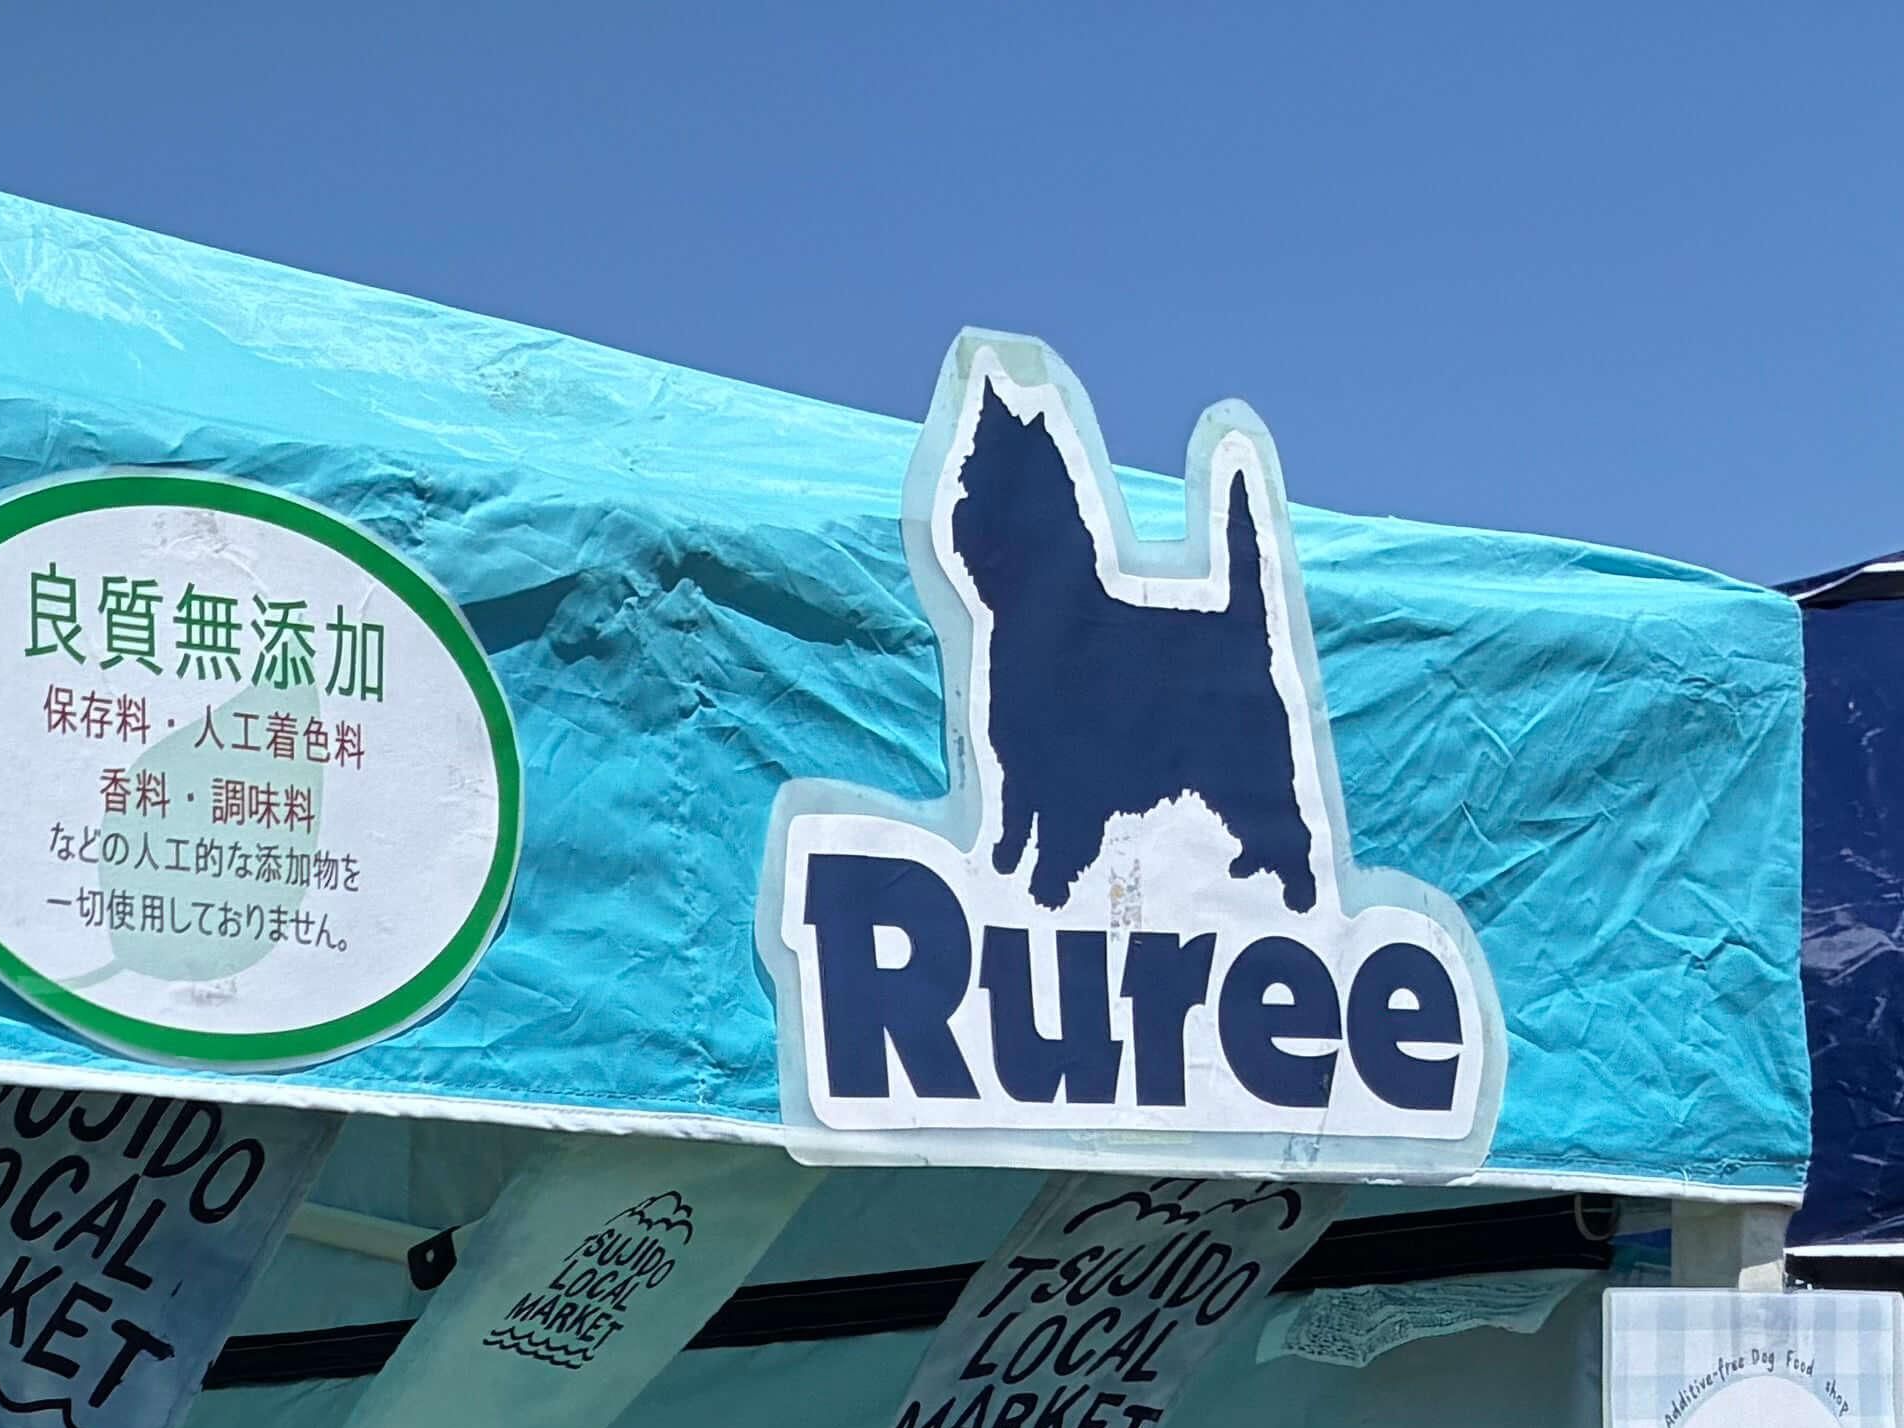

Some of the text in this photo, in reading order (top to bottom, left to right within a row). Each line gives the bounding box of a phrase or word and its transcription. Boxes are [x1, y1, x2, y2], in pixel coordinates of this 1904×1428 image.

[24, 563, 386, 702] 良質無添加
[49, 823, 359, 892] などの人工的な添加物を
[47, 891, 348, 951] 一切使用しておりません。
[804, 853, 1464, 1109] Ruree
[550, 1260, 639, 1311] LOCAL
[565, 1229, 675, 1288] TSUJIDO
[980, 1231, 1260, 1326] TSUJIDO
[505, 1293, 623, 1347] MARKET
[960, 1308, 1178, 1381] LOCAL
[1752, 1349, 1774, 1372] Dog
[1786, 1350, 1815, 1376] Food
